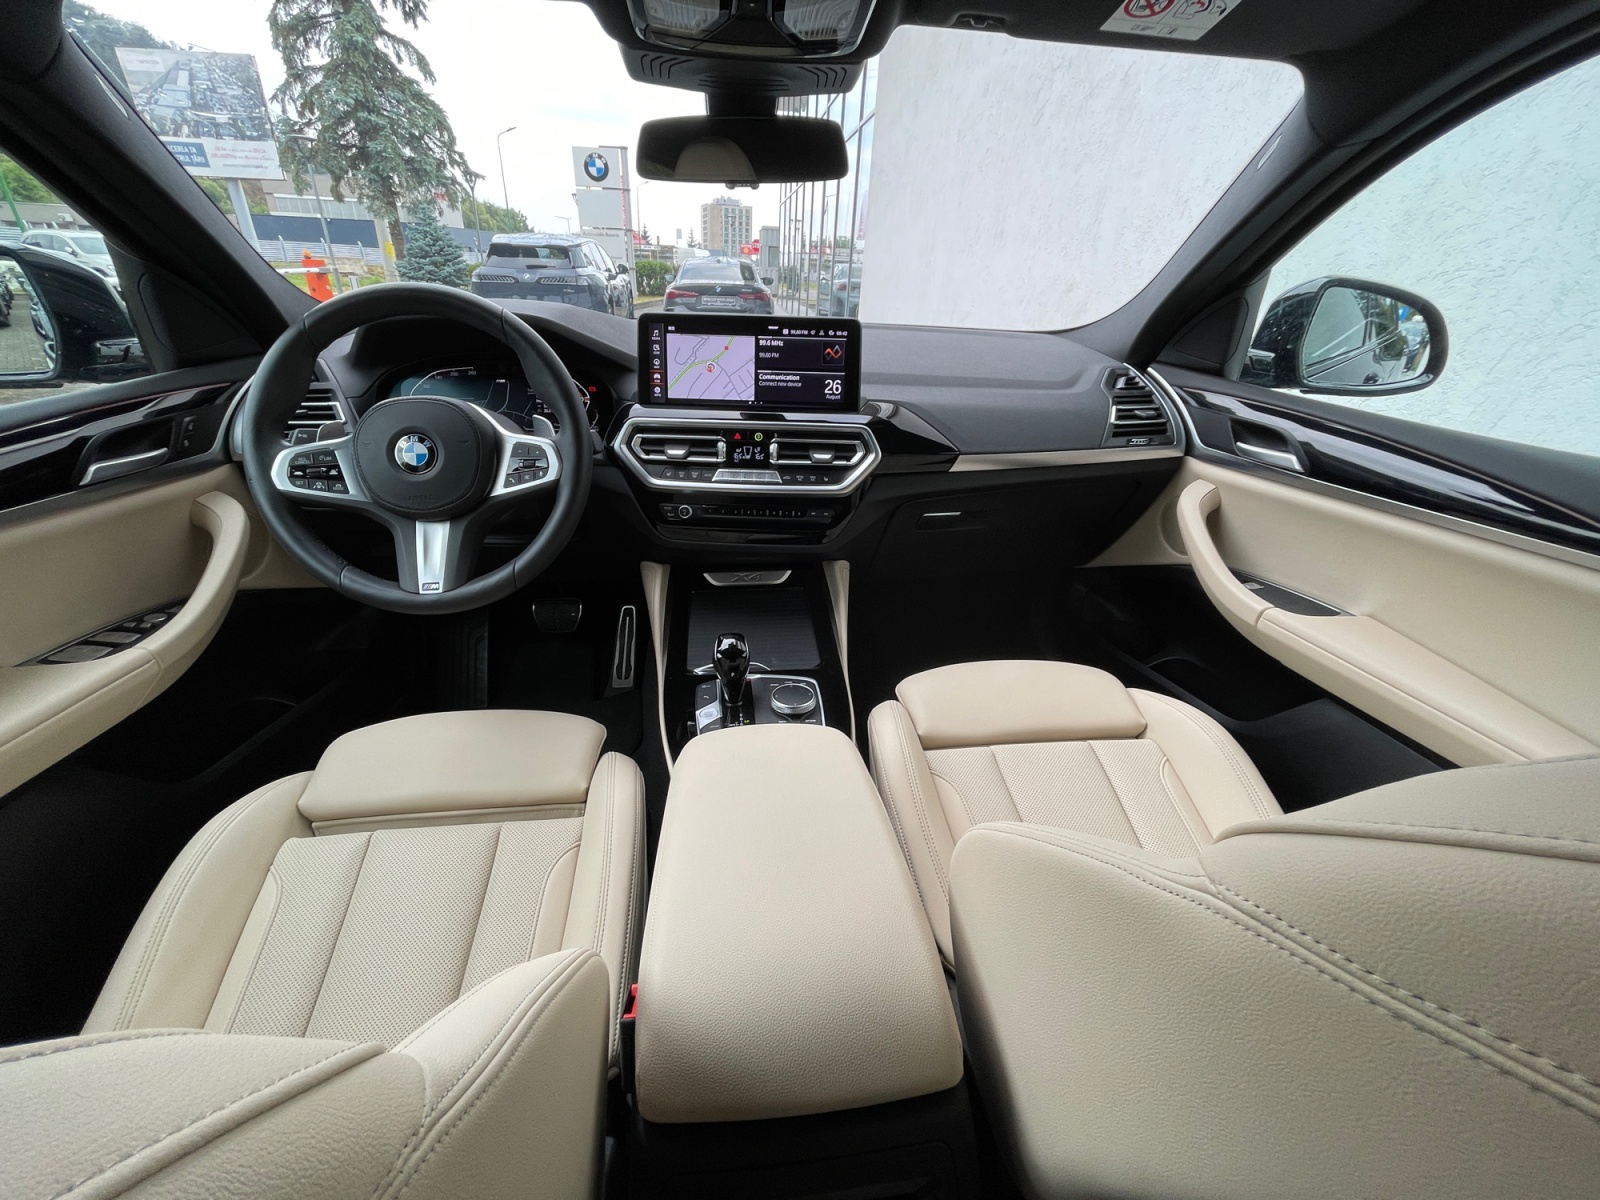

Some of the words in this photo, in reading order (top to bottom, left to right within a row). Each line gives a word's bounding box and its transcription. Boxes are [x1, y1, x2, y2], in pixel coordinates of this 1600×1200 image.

[585, 153, 607, 164] BMW
[758, 339, 772, 347] 99.6
[824, 379, 842, 395] 26
[398, 435, 432, 448] BMW
[731, 572, 765, 582] X4
